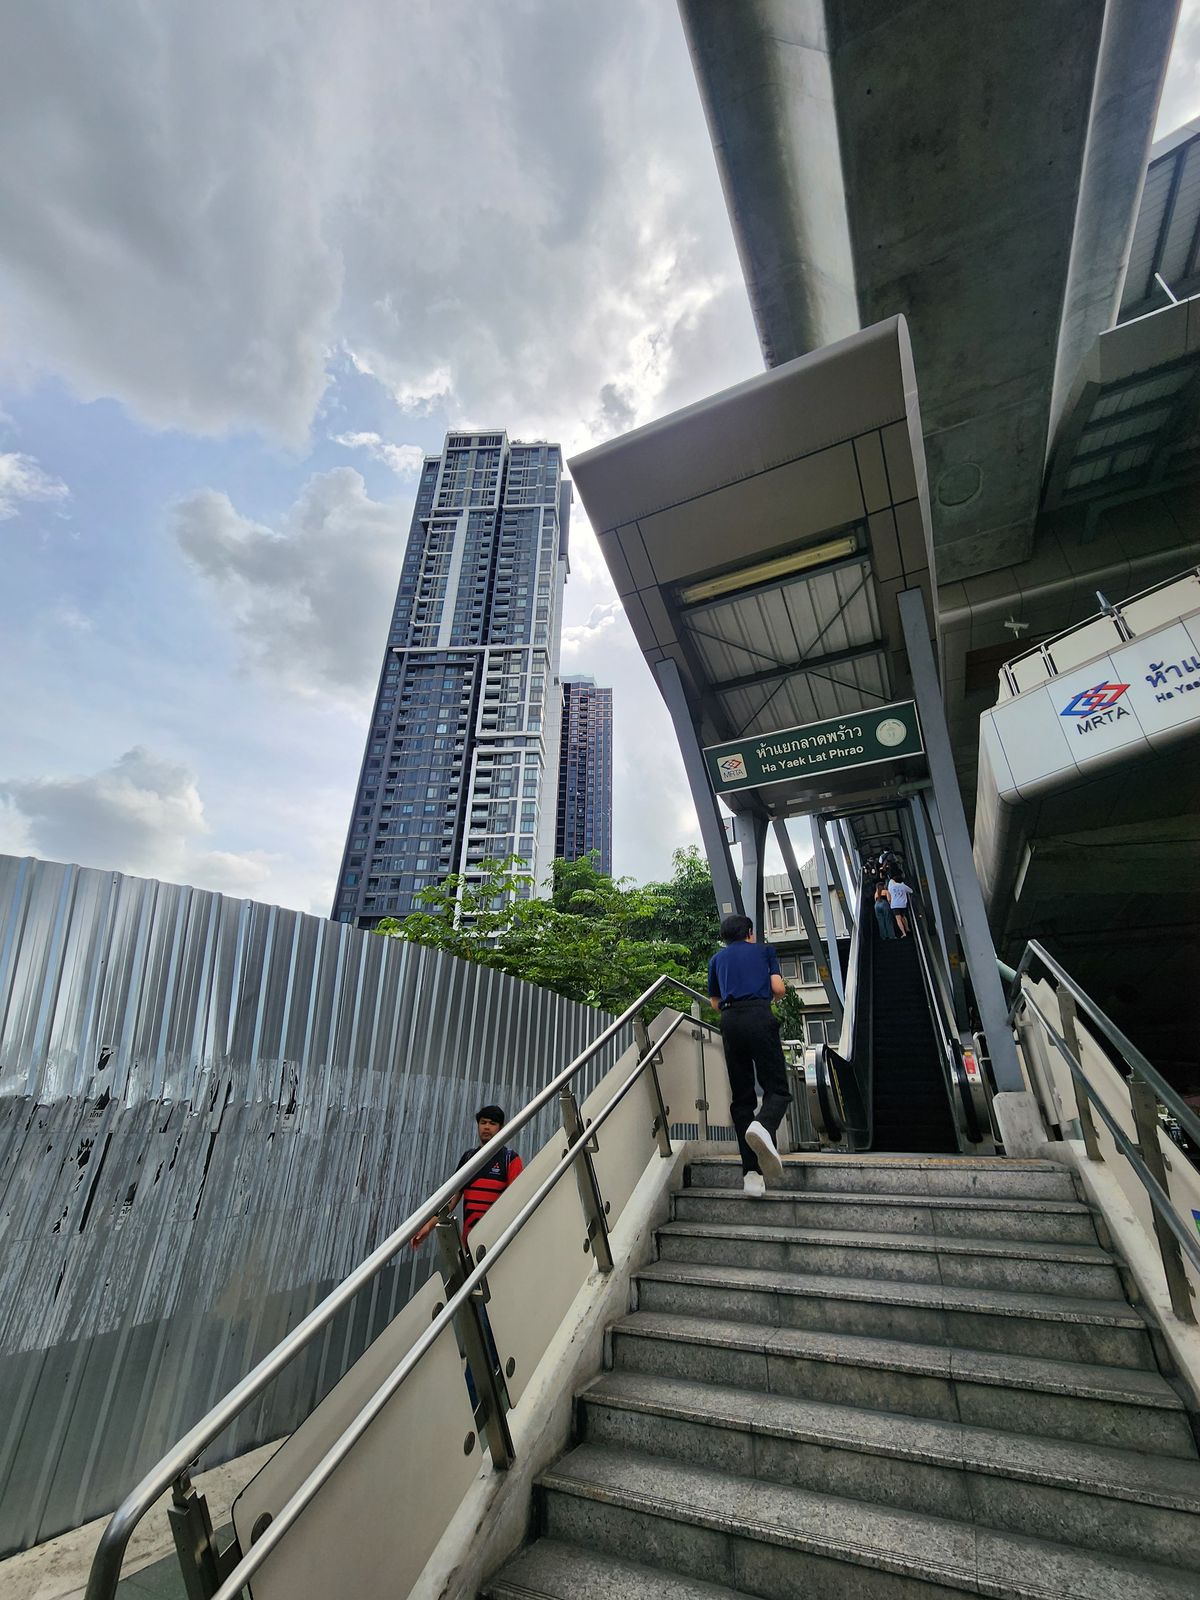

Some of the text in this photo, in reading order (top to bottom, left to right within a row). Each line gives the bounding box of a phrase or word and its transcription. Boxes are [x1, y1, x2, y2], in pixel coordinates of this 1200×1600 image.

[1155, 677, 1200, 703] Ha Yae
[1076, 706, 1130, 735] MRTA
[756, 724, 862, 759] ห้าแยกลาดพร้าว
[761, 745, 864, 774] Ha Yaek Lat Phrao
